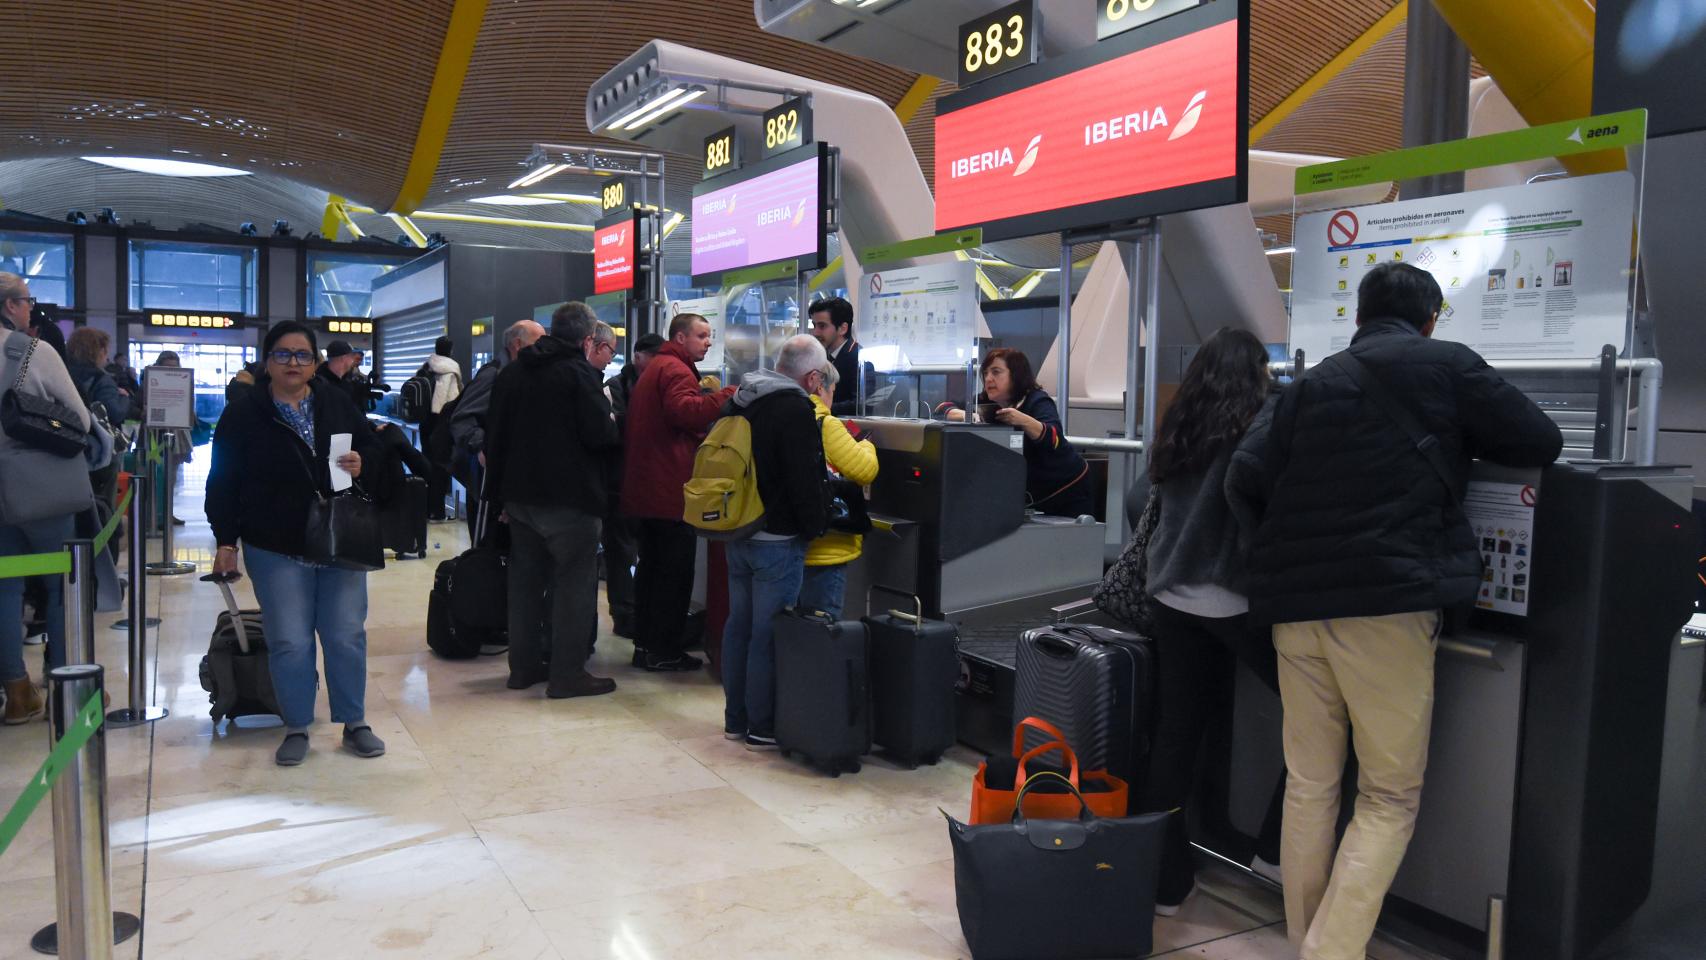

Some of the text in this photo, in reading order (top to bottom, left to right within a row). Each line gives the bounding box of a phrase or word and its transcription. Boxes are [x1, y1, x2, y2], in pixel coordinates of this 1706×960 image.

[965, 14, 1024, 73] 883
[766, 109, 798, 149] 882
[1084, 106, 1169, 146] IBERIA
[1586, 125, 1620, 138] aena
[706, 136, 731, 170] 881
[951, 147, 1014, 178] IBERIA
[603, 182, 623, 210] 880
[702, 199, 727, 216] IBERIA
[756, 205, 792, 227] IBERIA
[1392, 213, 1423, 223] prohibidos
[1433, 208, 1465, 217] aeronaves
[601, 232, 619, 246] IBERIA
